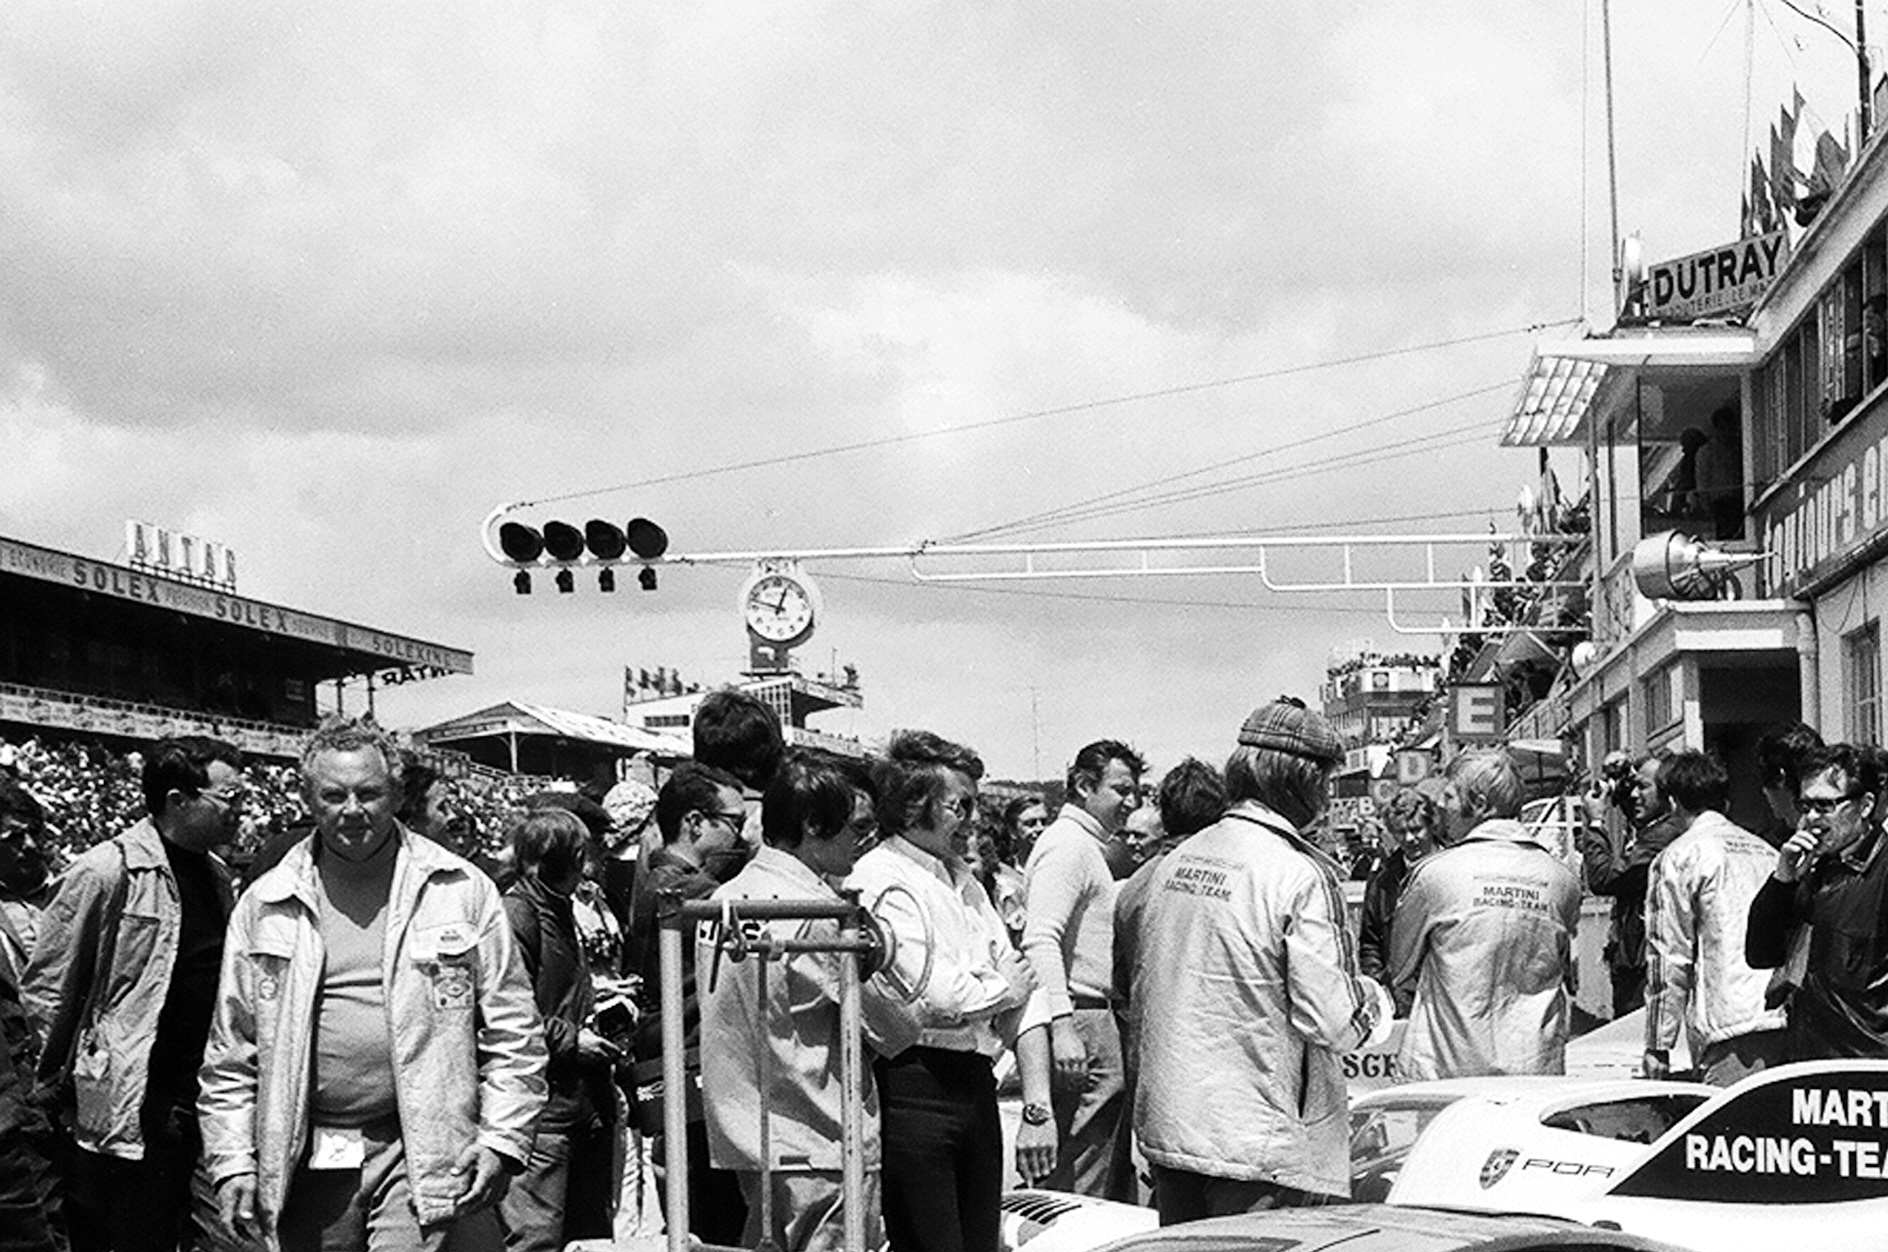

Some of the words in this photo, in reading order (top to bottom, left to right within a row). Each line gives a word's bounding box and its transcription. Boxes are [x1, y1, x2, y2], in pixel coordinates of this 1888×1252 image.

[1654, 234, 1783, 308] DUTRAY
[1763, 462, 1856, 598] toujours
[72, 560, 160, 603] SOLEX
[213, 596, 288, 633] SOLEX
[1457, 687, 1496, 733] E
[1483, 886, 1540, 900] MARTINI
